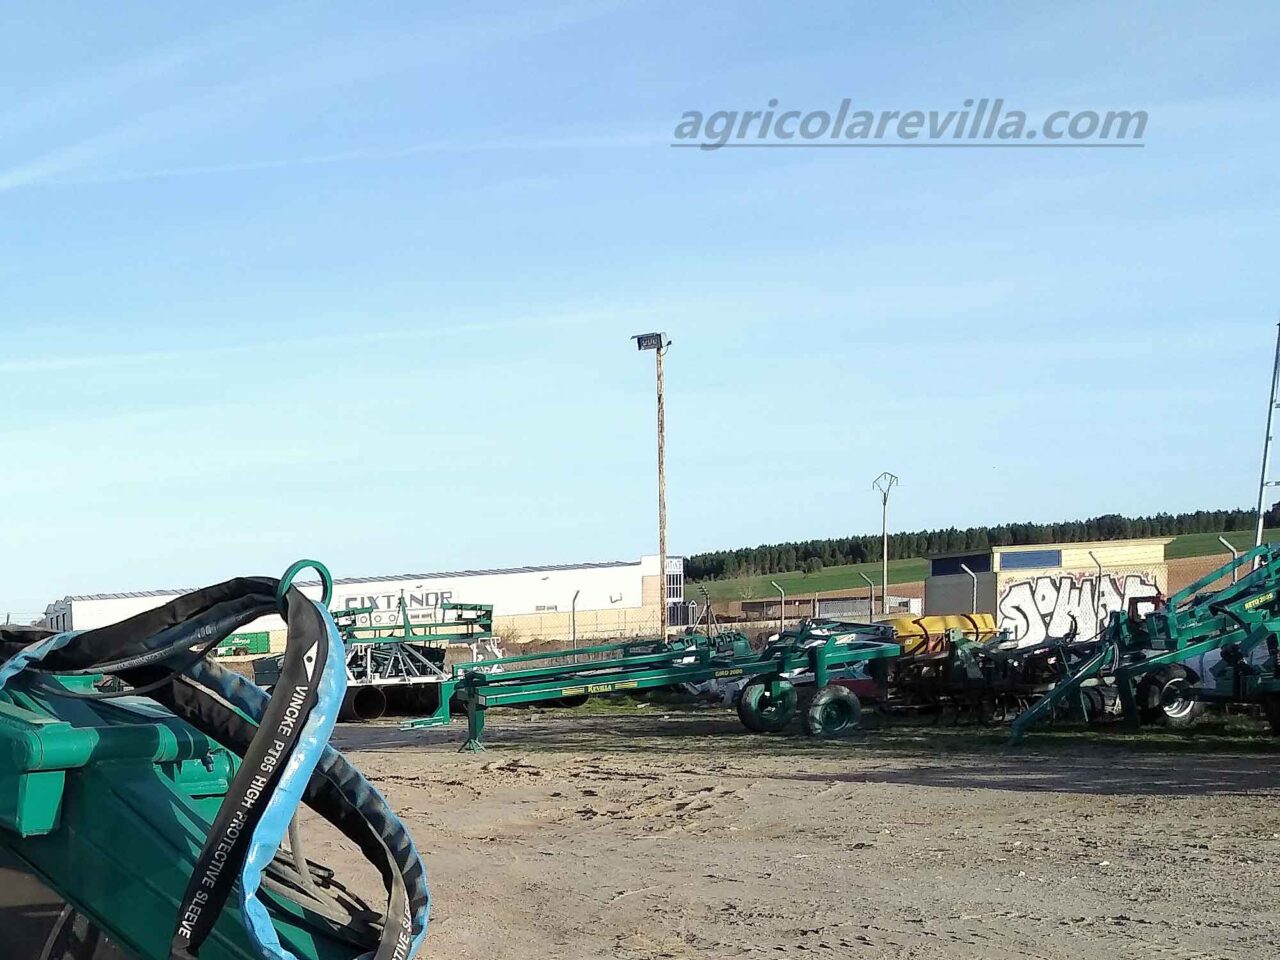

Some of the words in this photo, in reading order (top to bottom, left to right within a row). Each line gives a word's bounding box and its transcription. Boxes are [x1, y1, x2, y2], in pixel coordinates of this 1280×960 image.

[277, 685, 309, 737] VINCKE
[260, 739, 285, 773] PT65
[241, 775, 267, 809] HIGH
[202, 811, 248, 889] PROTECTIVE
[178, 890, 209, 939] SLEEVE
